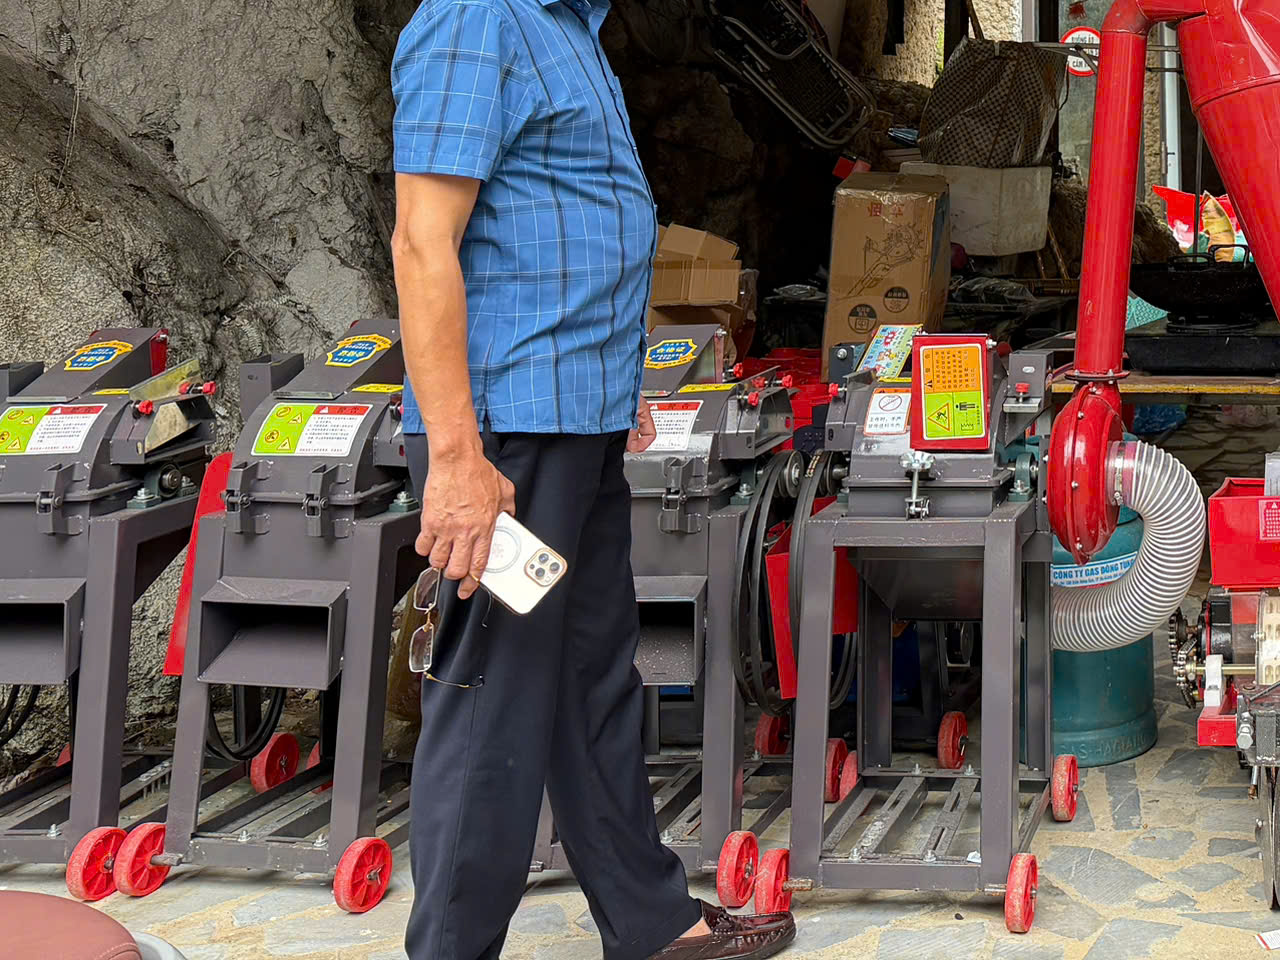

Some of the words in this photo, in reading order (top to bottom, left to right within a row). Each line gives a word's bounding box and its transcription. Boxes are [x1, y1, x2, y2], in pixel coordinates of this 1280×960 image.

[1053, 569, 1073, 580] CÔNG
[1074, 569, 1084, 578] TY
[1084, 566, 1100, 578] GAS
